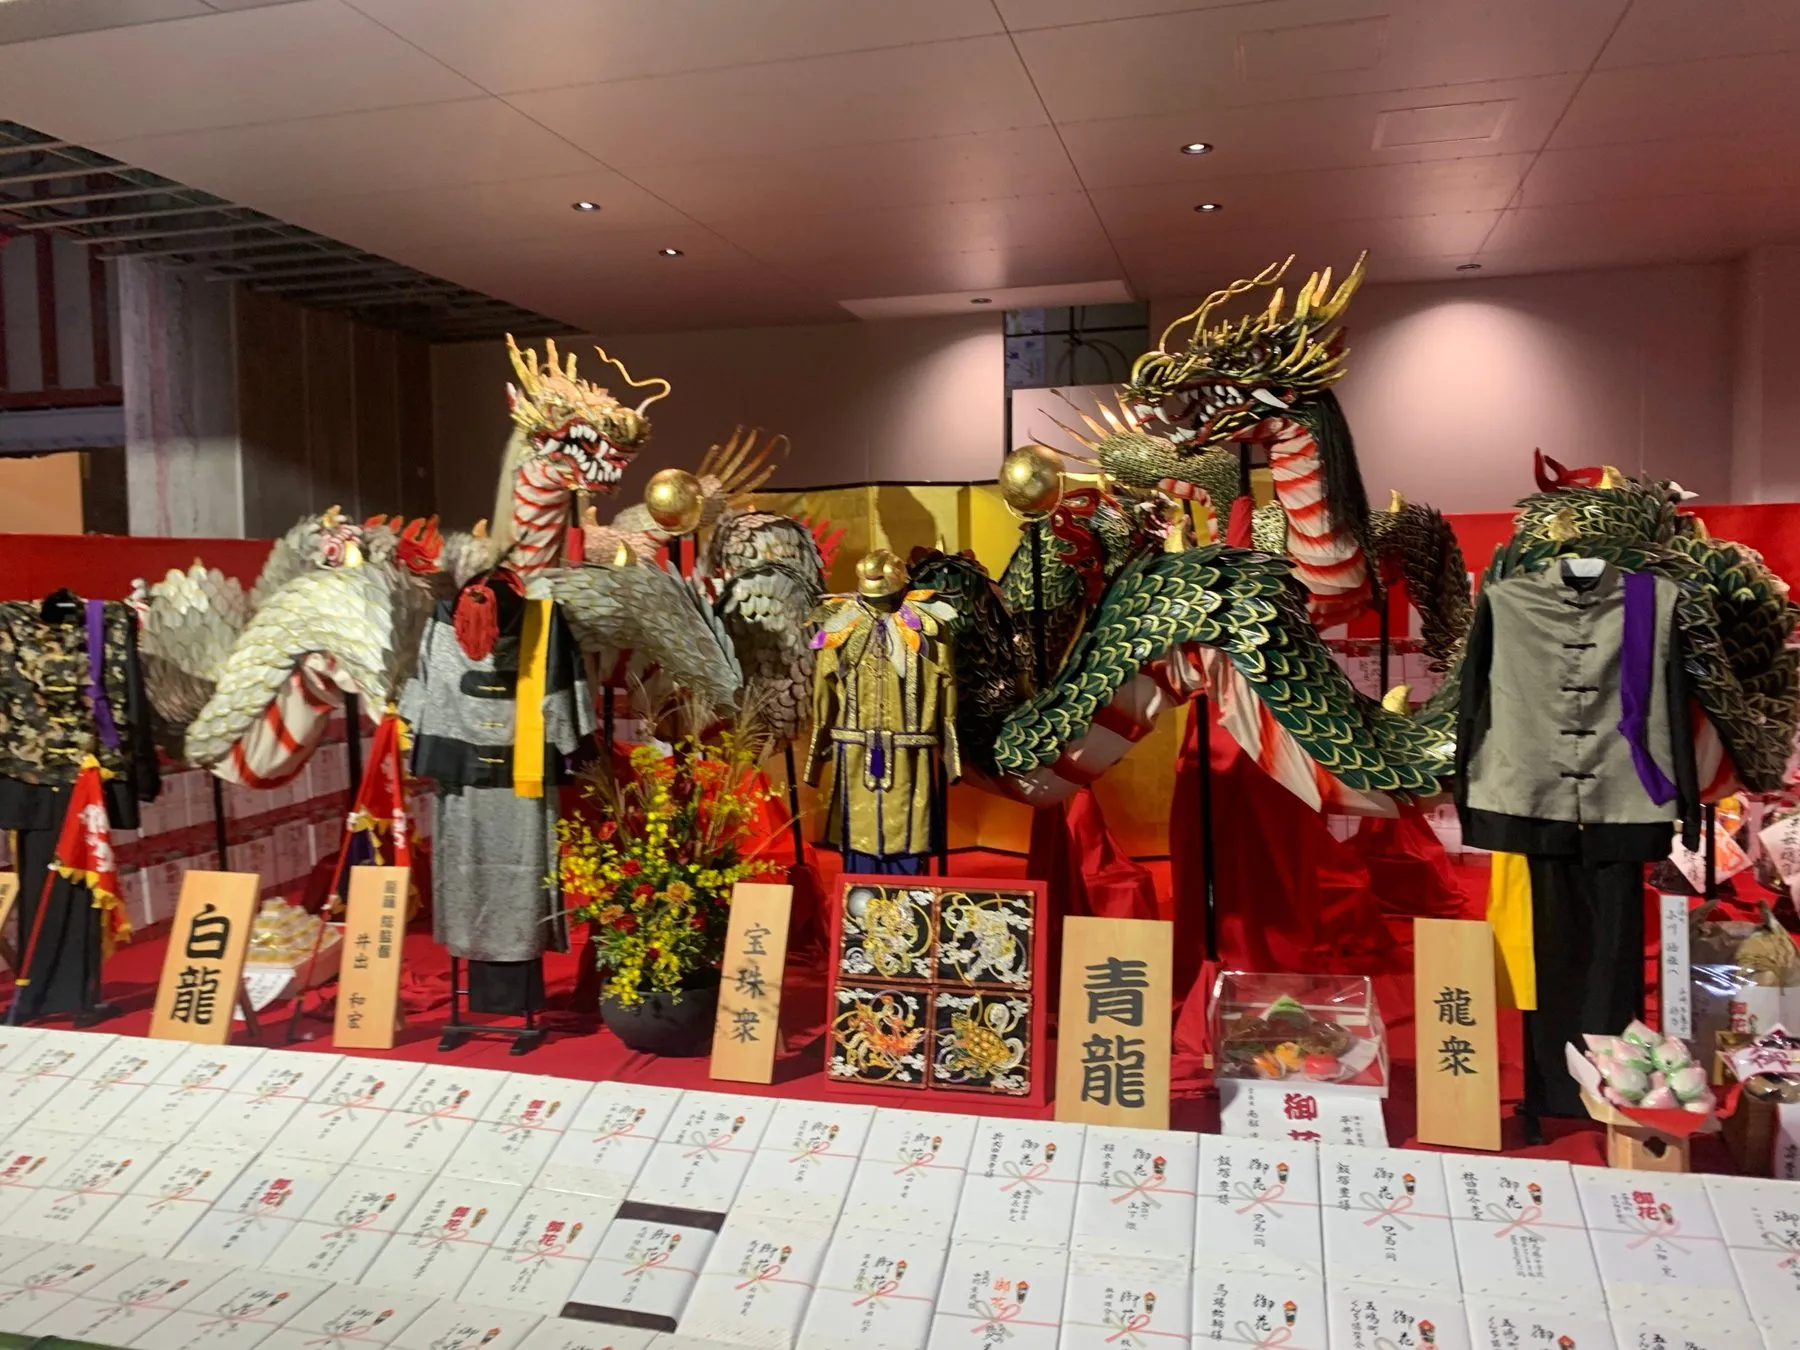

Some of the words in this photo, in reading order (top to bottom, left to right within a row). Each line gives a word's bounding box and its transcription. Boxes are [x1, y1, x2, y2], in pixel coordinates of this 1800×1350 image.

[170, 903, 231, 1025] 白龍
[729, 922, 771, 1044] 宝珠衆
[1080, 956, 1150, 1109] 青龍
[1433, 985, 1479, 1077] 龍衆
[520, 1099, 546, 1121] 御花
[1020, 1138, 1040, 1167] 御花
[1133, 1148, 1154, 1177] 御花
[259, 1178, 293, 1205] 御花
[1248, 1157, 1270, 1192] 御花
[1373, 1167, 1396, 1201] 御花
[1499, 1176, 1523, 1209] 御花
[1632, 1190, 1661, 1221] 御花
[441, 1205, 472, 1232] 御花
[537, 1220, 566, 1247] 御花
[642, 1227, 671, 1261] 御花
[755, 1243, 779, 1273] 御花
[870, 1256, 894, 1291] 御花
[990, 1278, 1011, 1311] 御花
[1119, 1290, 1141, 1325] 御花
[1252, 1293, 1277, 1332] 御花
[1392, 1309, 1415, 1347] 御花
